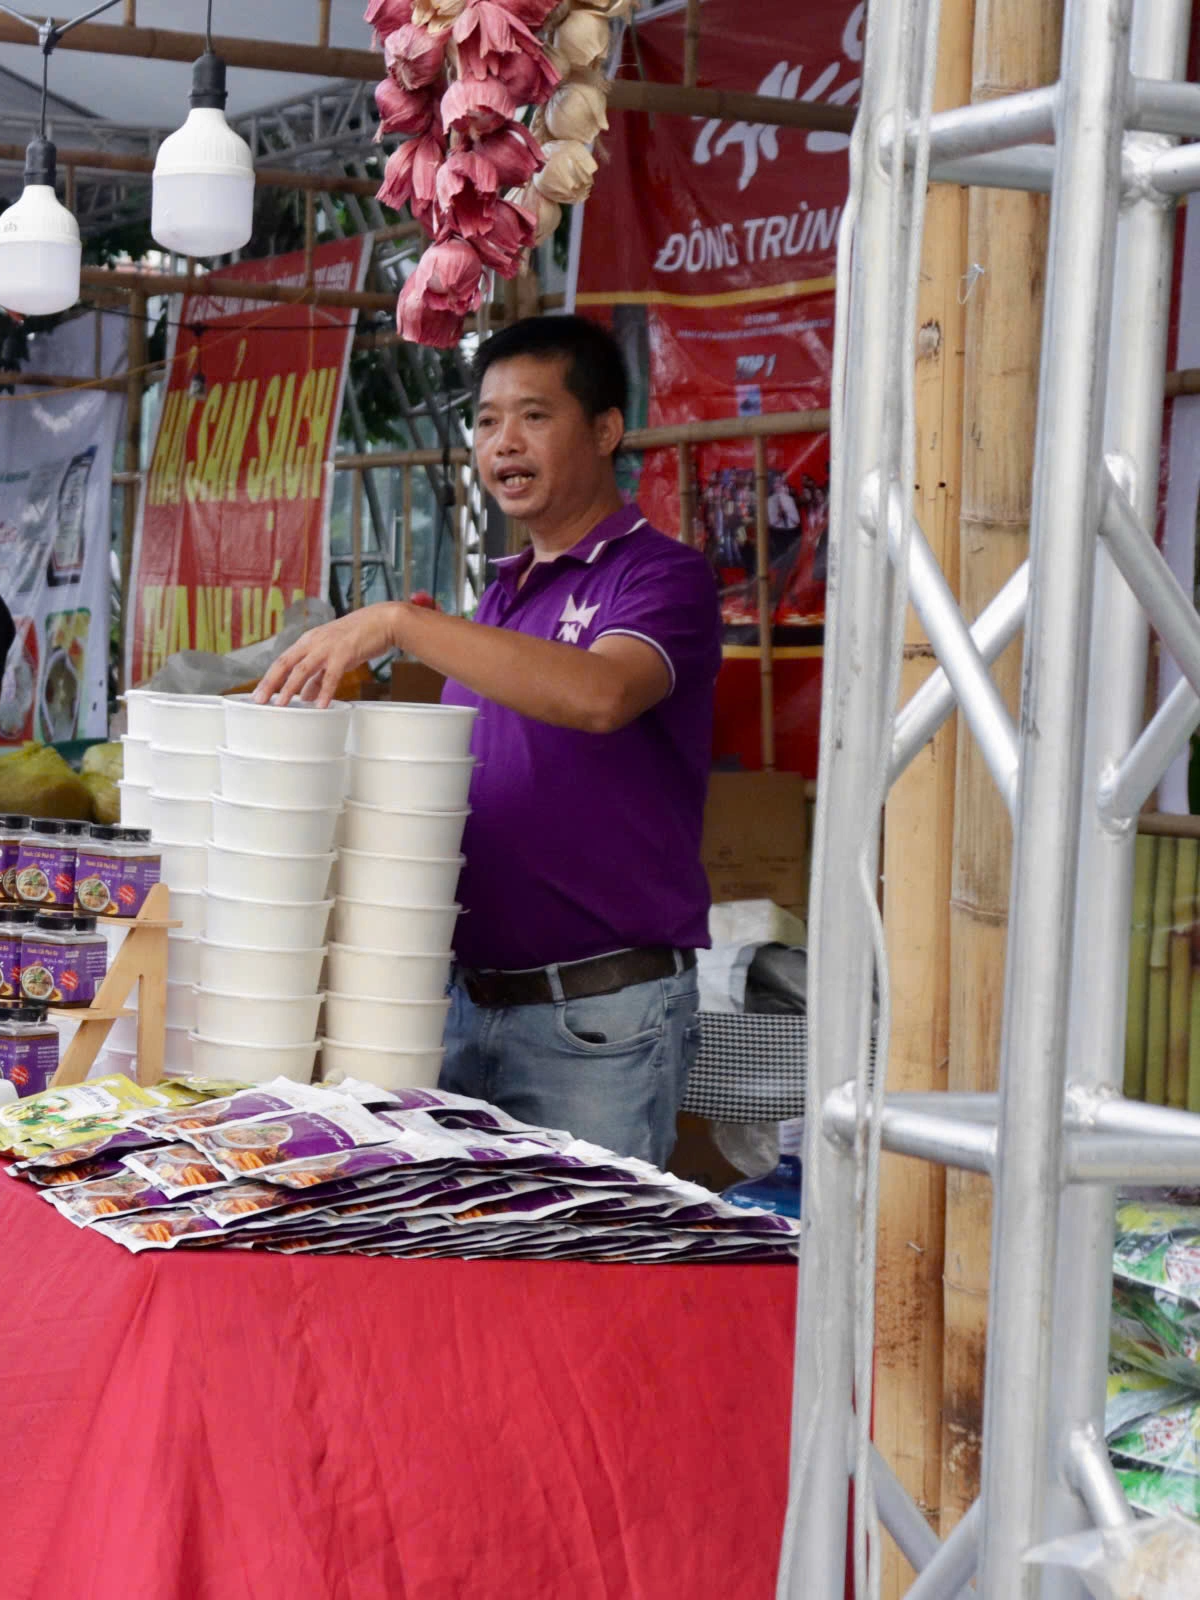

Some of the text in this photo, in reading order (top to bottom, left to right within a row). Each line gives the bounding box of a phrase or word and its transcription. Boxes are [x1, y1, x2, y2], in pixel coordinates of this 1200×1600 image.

[654, 200, 840, 273] ĐÔNG TRÙN
[185, 338, 259, 503] SẢN
[247, 367, 338, 530] SẠCH
